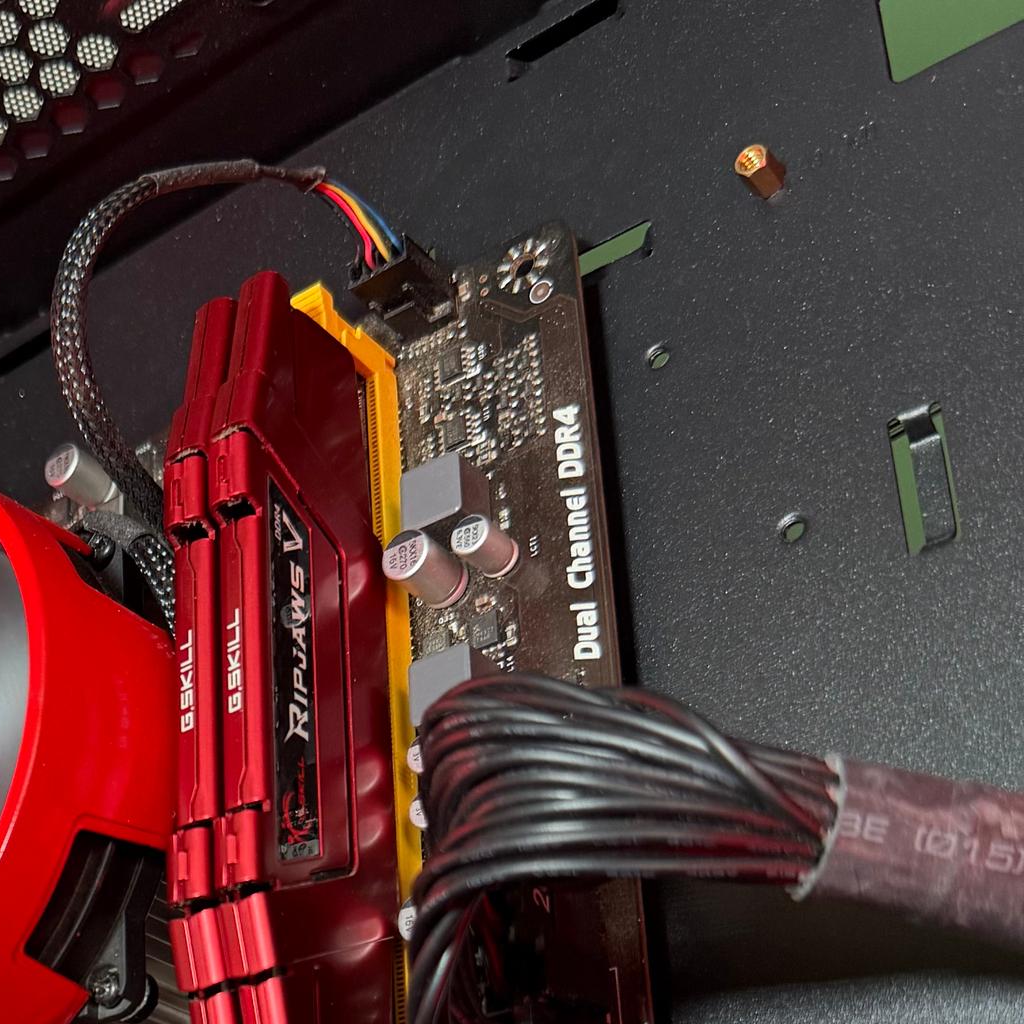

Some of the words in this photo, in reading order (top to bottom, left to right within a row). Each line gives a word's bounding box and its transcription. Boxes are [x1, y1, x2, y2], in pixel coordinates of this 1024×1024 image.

[553, 404, 585, 479] DDR4
[282, 510, 304, 553] V
[560, 487, 595, 589] Channel
[226, 607, 242, 714] G.SKILL
[569, 602, 601, 660] Dual
[179, 629, 194, 733] G.SKILL
